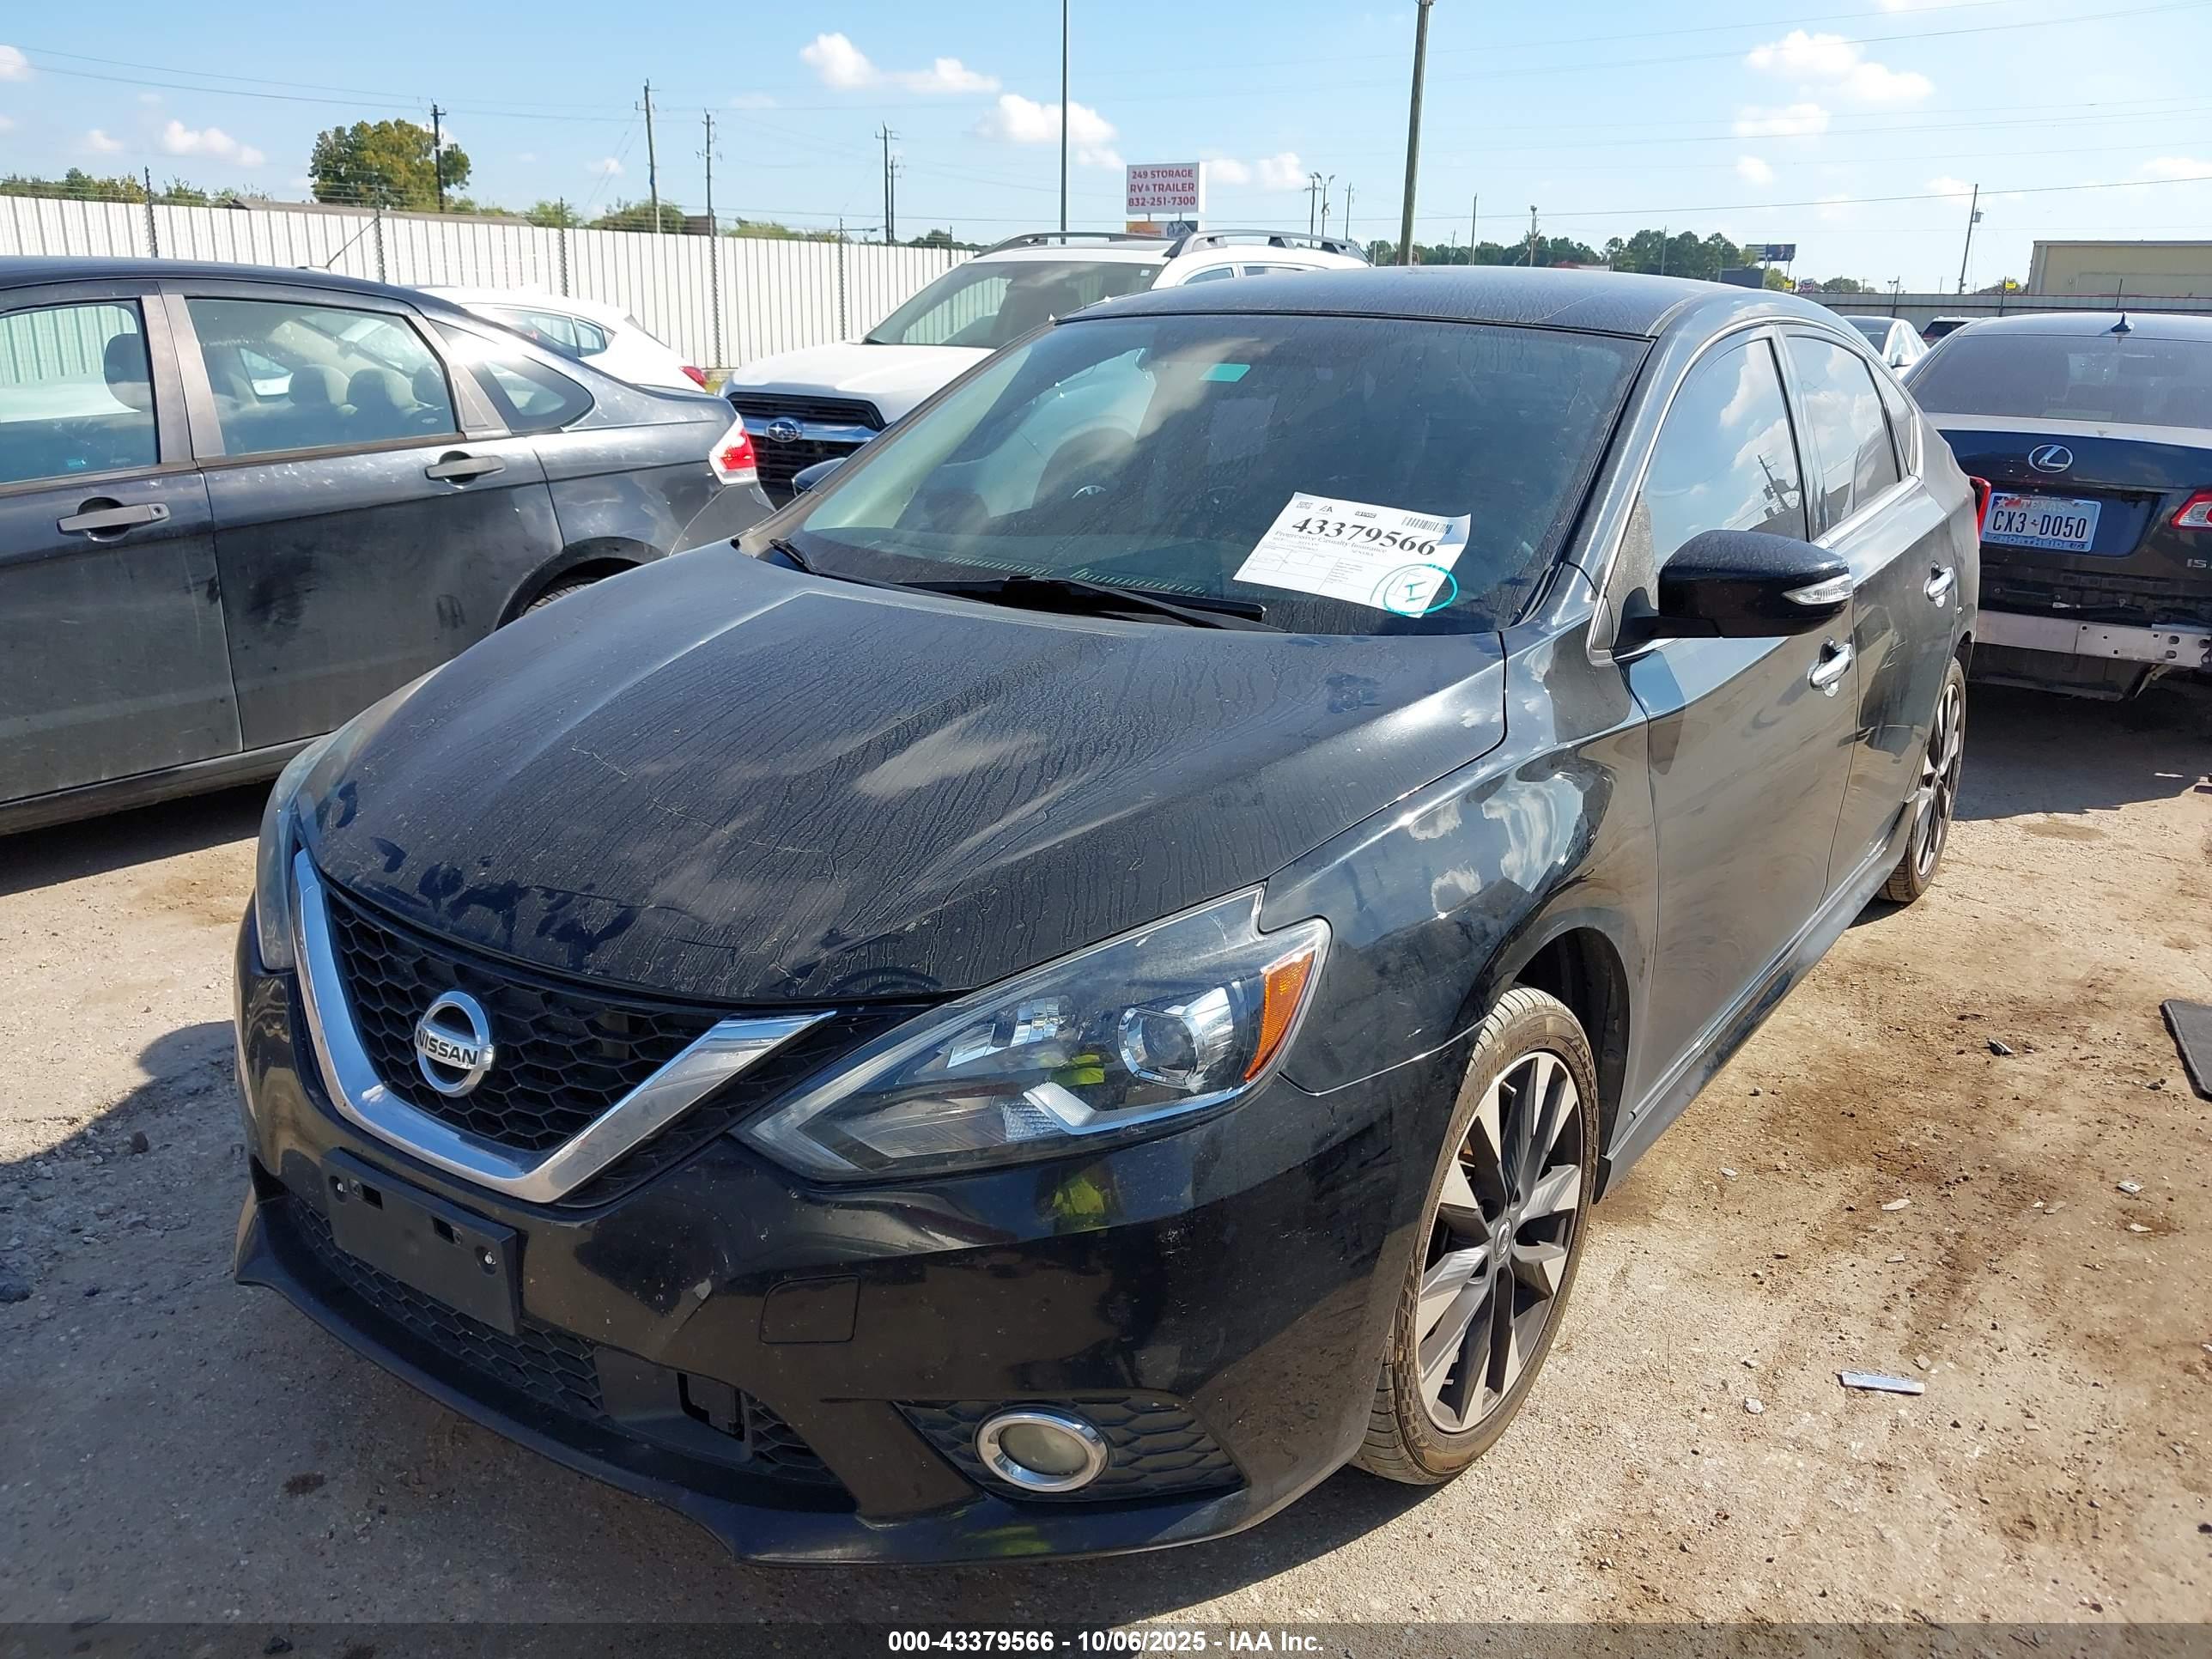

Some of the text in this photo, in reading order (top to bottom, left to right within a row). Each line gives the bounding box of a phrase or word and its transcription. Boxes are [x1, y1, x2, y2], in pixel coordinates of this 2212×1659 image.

[1132, 169, 1194, 179] 249 STORAGE
[1130, 184, 1144, 192] RV
[1152, 183, 1194, 191] TRAILER
[1128, 196, 1195, 206] 832-251-7300
[2021, 500, 2067, 513] TEXAS
[1992, 510, 2027, 533] CX3
[1291, 518, 1440, 556] 43379566
[2187, 558, 2207, 568] IS
[416, 1029, 478, 1066] NISSAN
